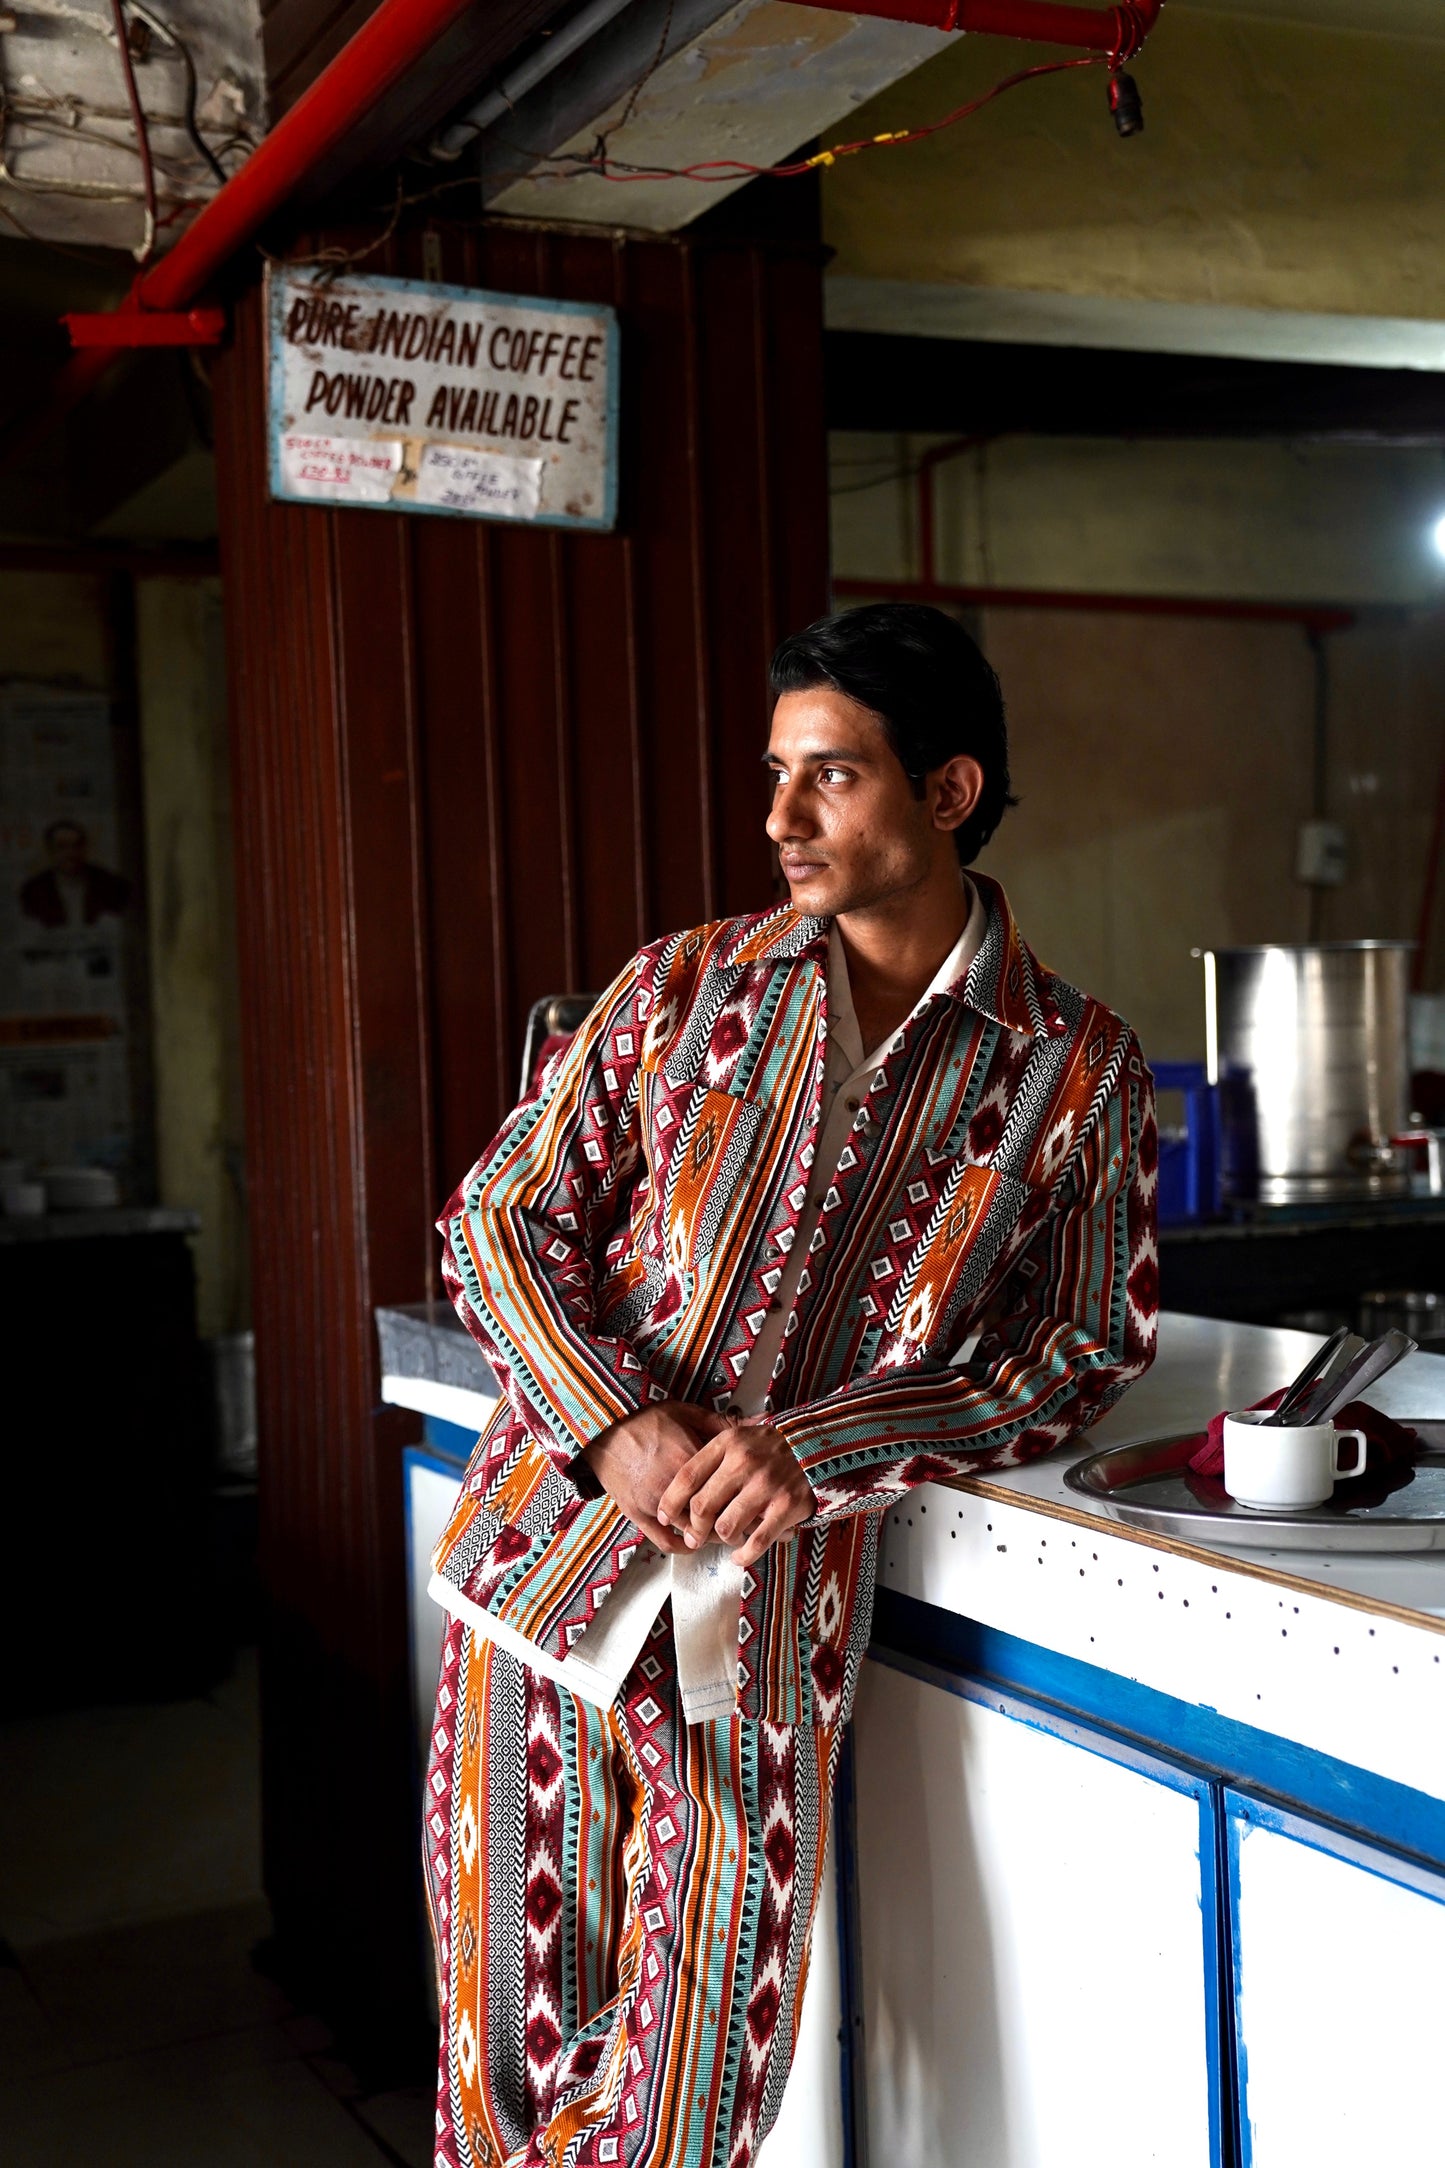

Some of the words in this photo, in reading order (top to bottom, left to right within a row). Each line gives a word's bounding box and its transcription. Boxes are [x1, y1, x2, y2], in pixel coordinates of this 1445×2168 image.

[287, 298, 360, 350] PURE
[368, 308, 483, 368] INDIAN
[489, 326, 603, 382] COFFEE
[304, 370, 416, 426] POWDER
[426, 385, 580, 444] AVAILABLE
